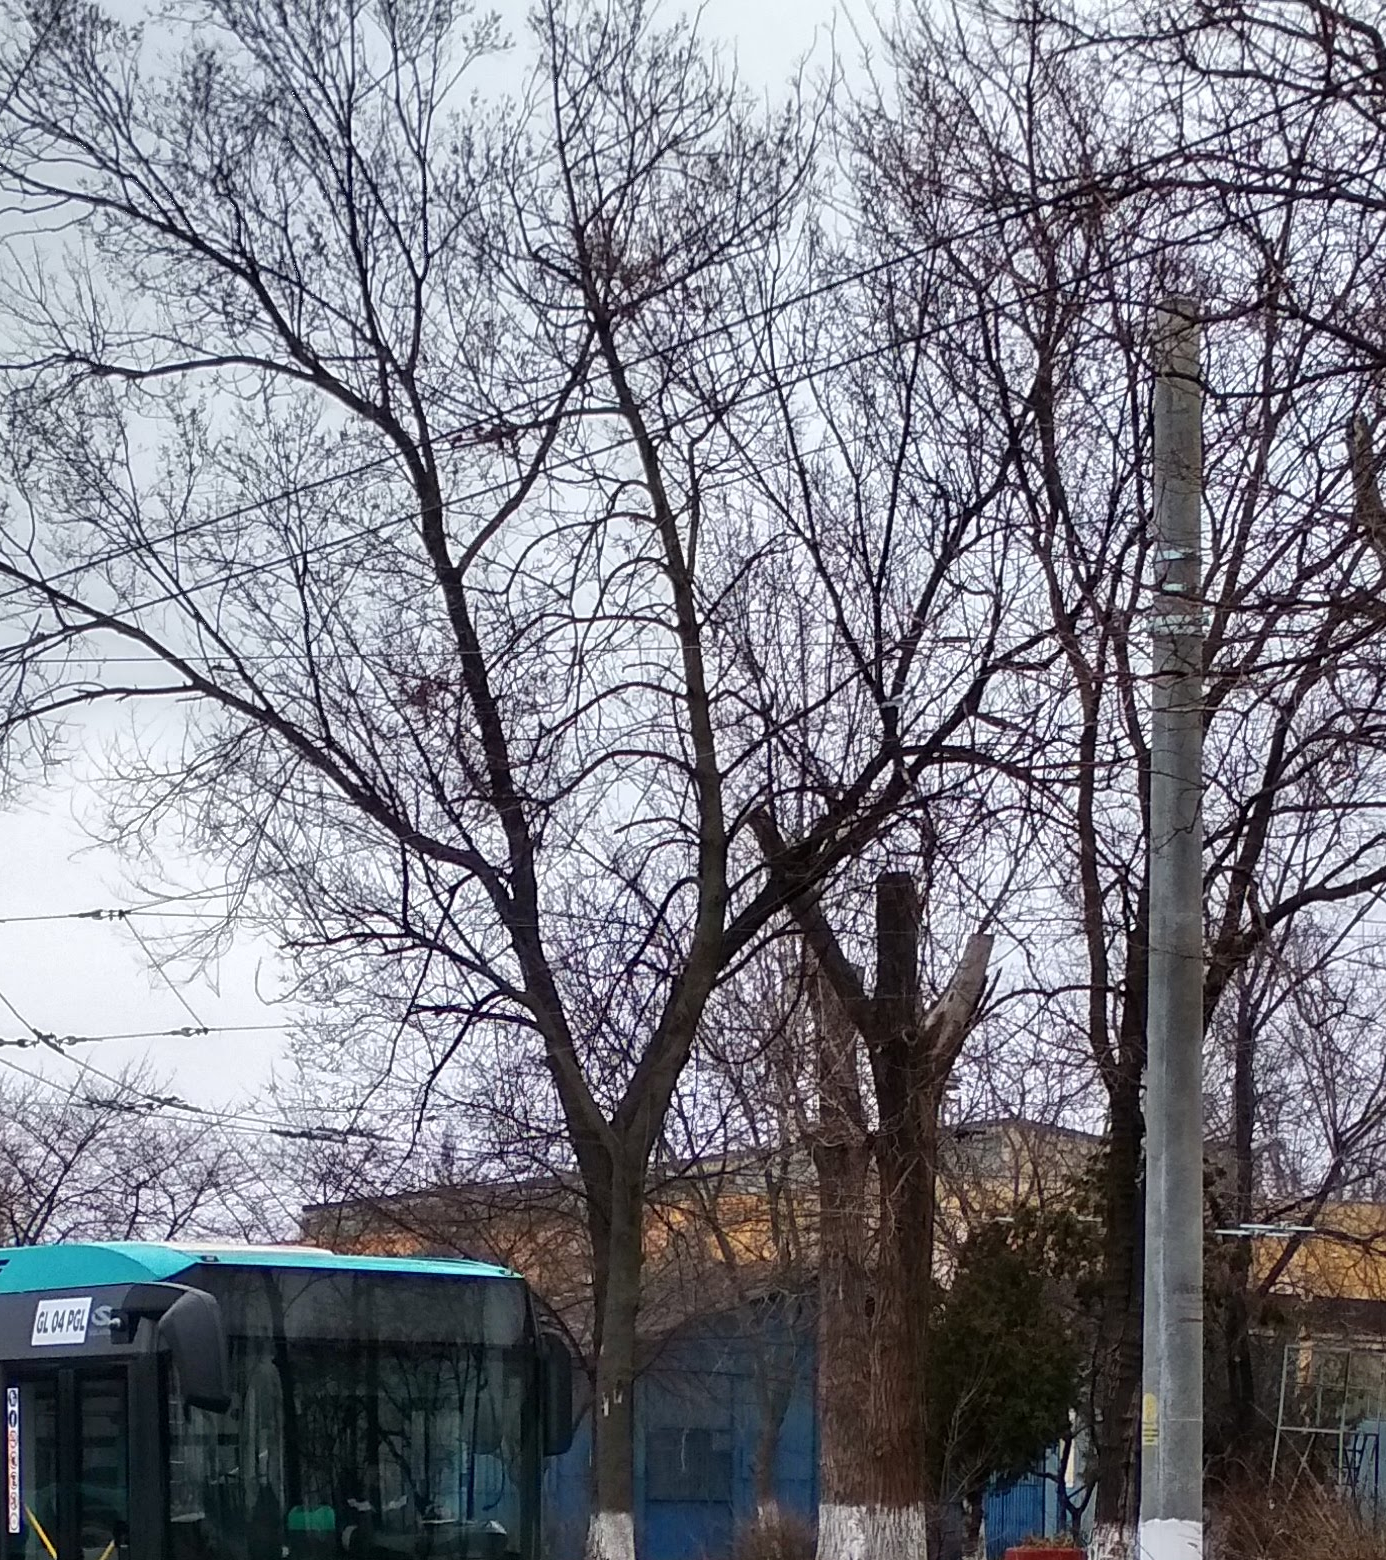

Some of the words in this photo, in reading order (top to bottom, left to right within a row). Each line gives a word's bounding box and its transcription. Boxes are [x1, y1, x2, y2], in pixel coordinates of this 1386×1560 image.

[36, 1311, 49, 1334] GL
[51, 1309, 66, 1333] 04
[66, 1308, 86, 1333] PGL
